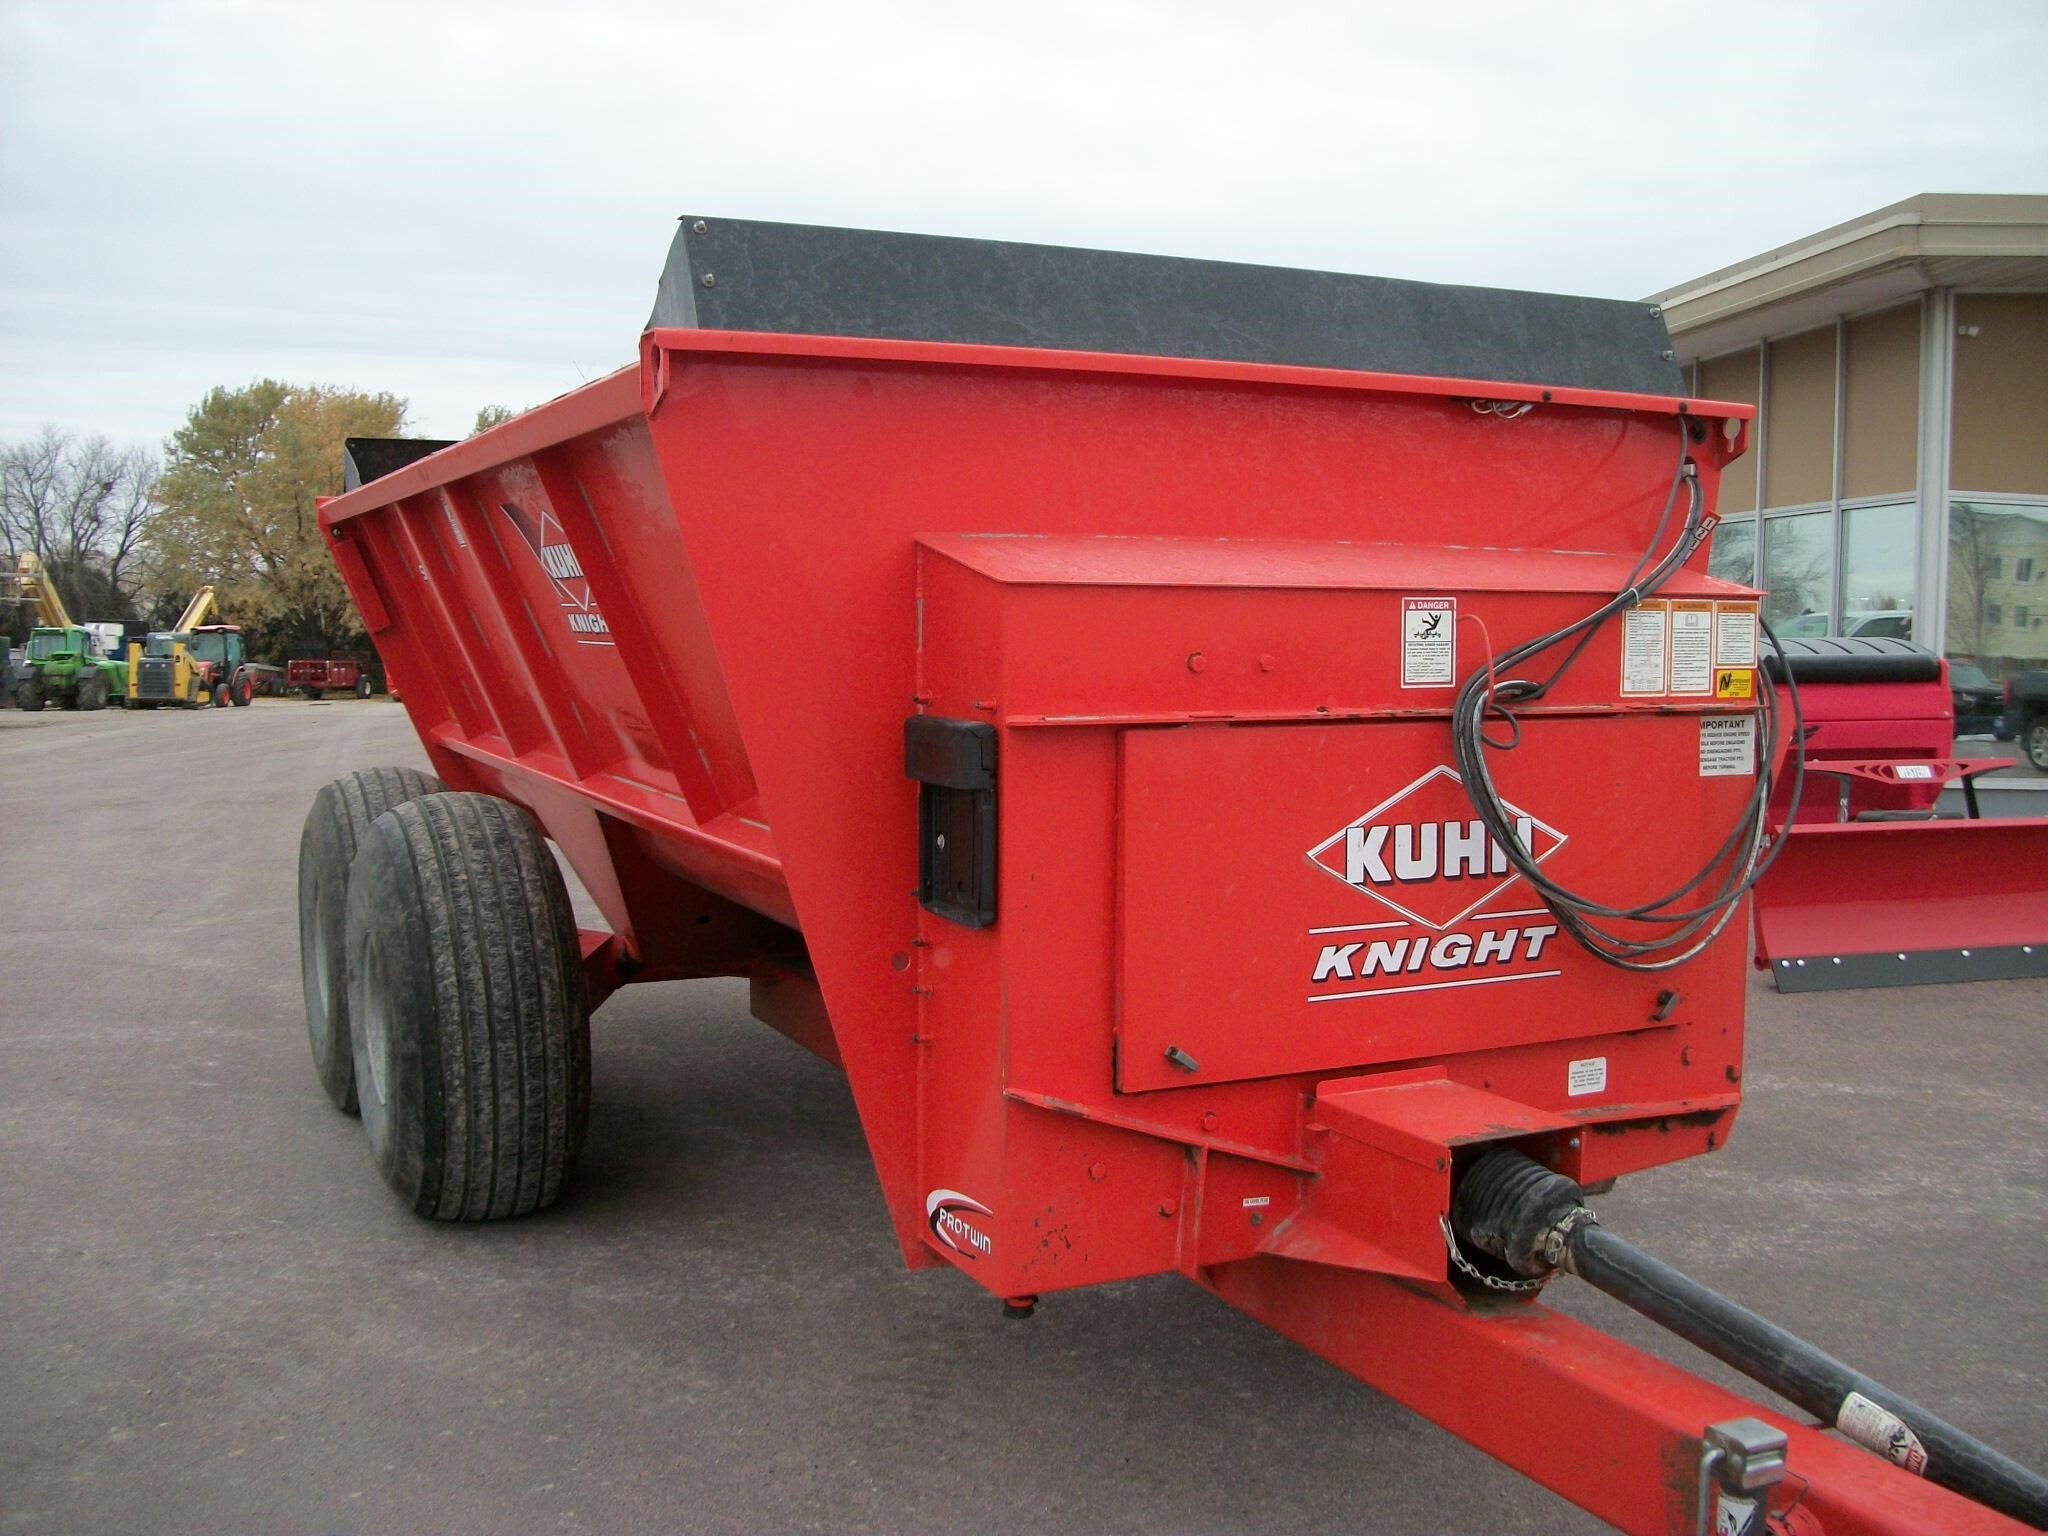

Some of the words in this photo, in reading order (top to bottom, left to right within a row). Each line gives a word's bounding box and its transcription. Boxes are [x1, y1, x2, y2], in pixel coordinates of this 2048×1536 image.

[541, 543, 584, 579] KUH
[1417, 601, 1449, 610] DANGER
[568, 613, 610, 633] KNIGH
[1700, 720, 1745, 729] MPORTANT
[1311, 925, 1558, 983] KNIGHT
[939, 1207, 991, 1255] PROTWIN
